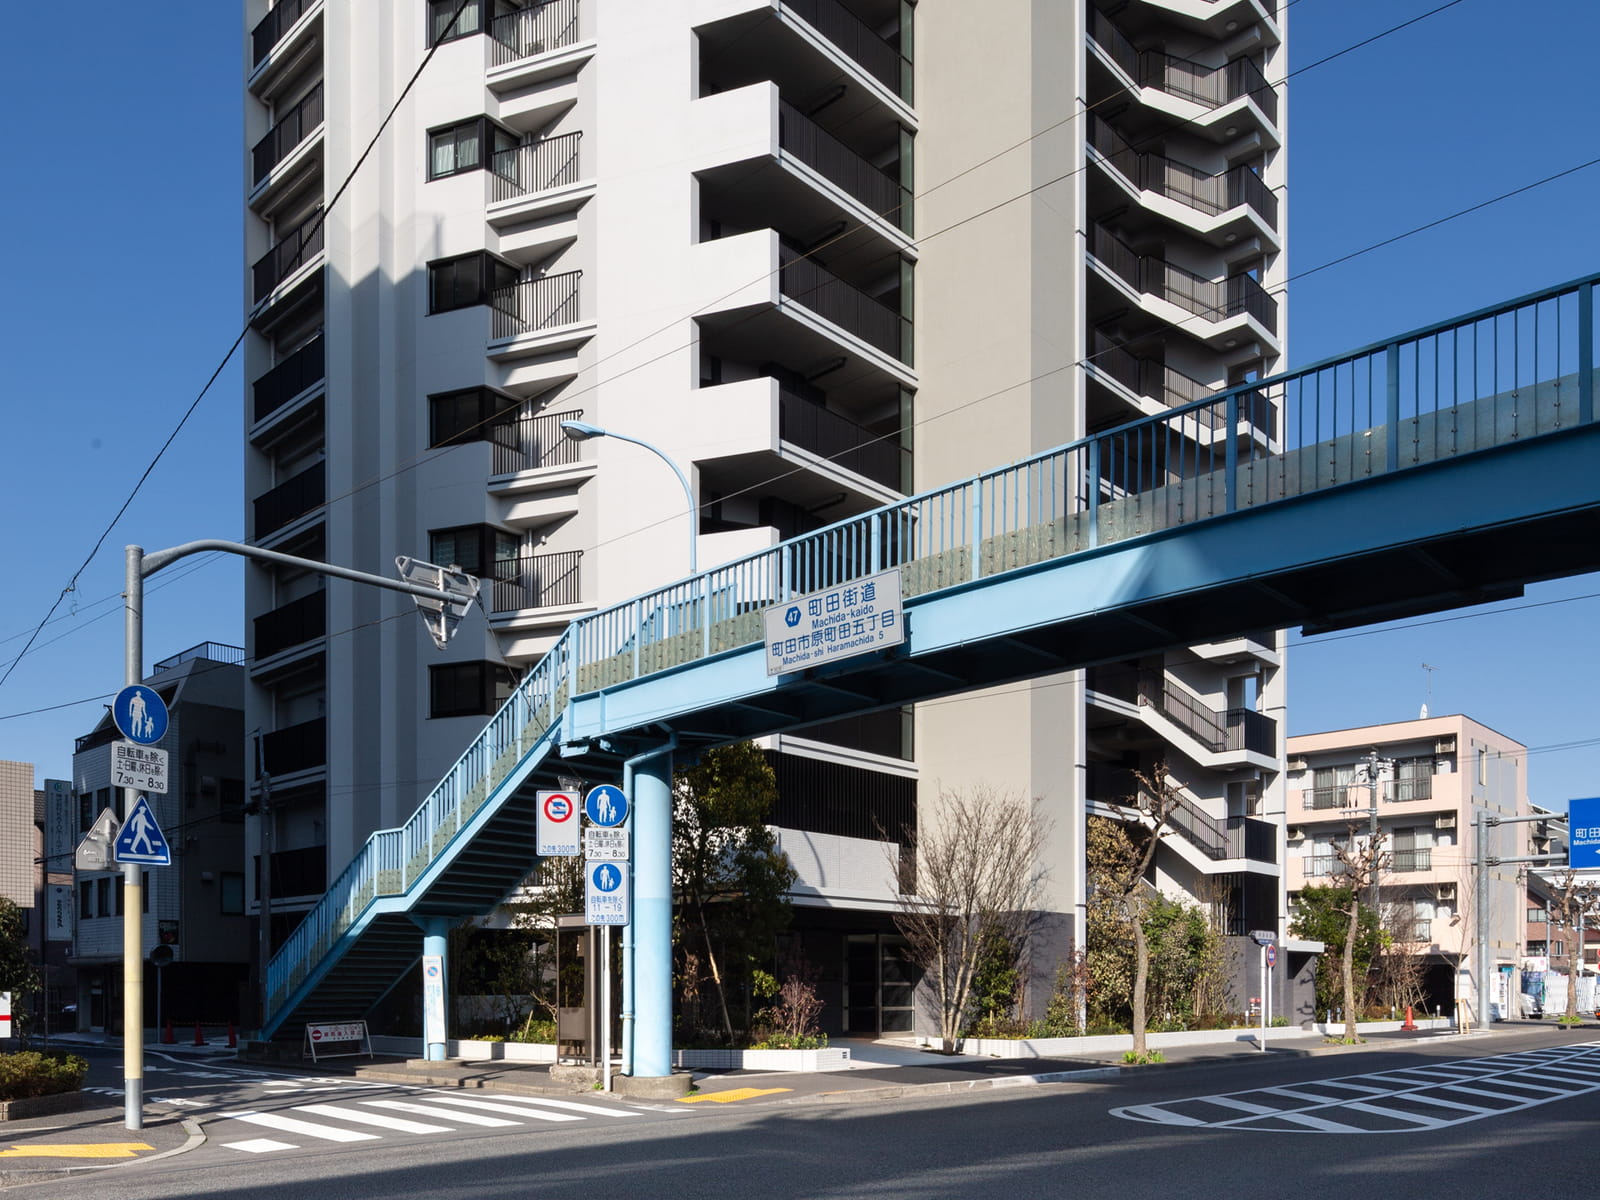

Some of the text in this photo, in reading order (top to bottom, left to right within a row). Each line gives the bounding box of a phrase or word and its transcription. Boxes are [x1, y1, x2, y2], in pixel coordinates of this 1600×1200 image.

[808, 581, 876, 617] 町田街道
[788, 609, 799, 624] 47
[811, 604, 874, 630] Machida-kaido
[771, 609, 894, 657] 町田市原町田五丁目
[782, 630, 884, 665] Machida-shi Haramachida 5
[116, 745, 164, 763] 自転車を除く
